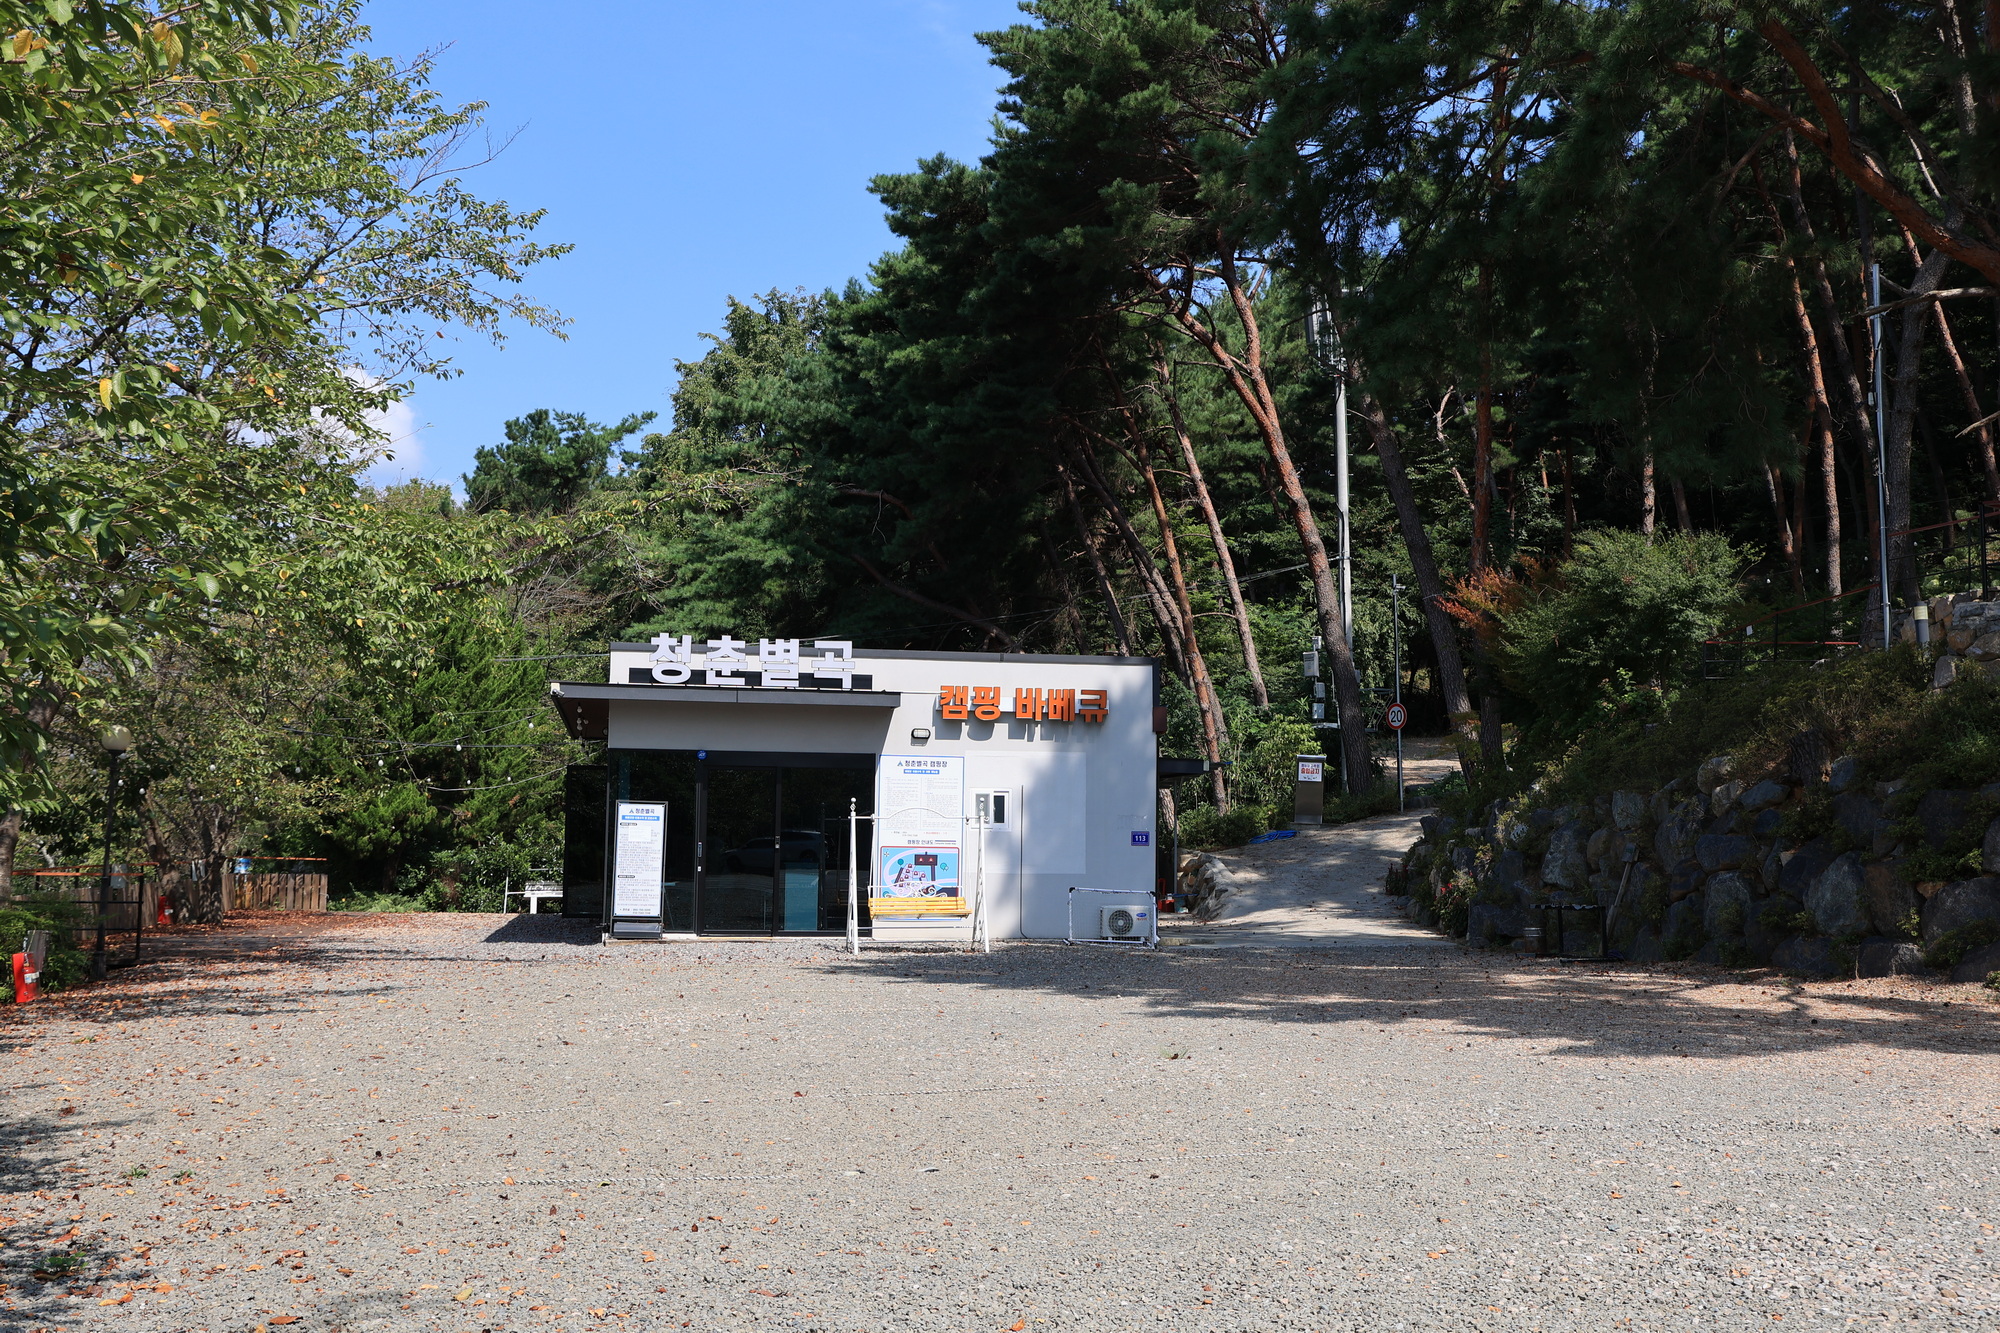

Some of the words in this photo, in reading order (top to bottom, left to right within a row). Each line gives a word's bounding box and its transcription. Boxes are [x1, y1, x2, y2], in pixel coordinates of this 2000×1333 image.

[649, 632, 855, 690] 청춘별곡
[939, 685, 1001, 721] 캠핑
[1015, 688, 1109, 723] 바베큐
[1390, 710, 1402, 723] 20
